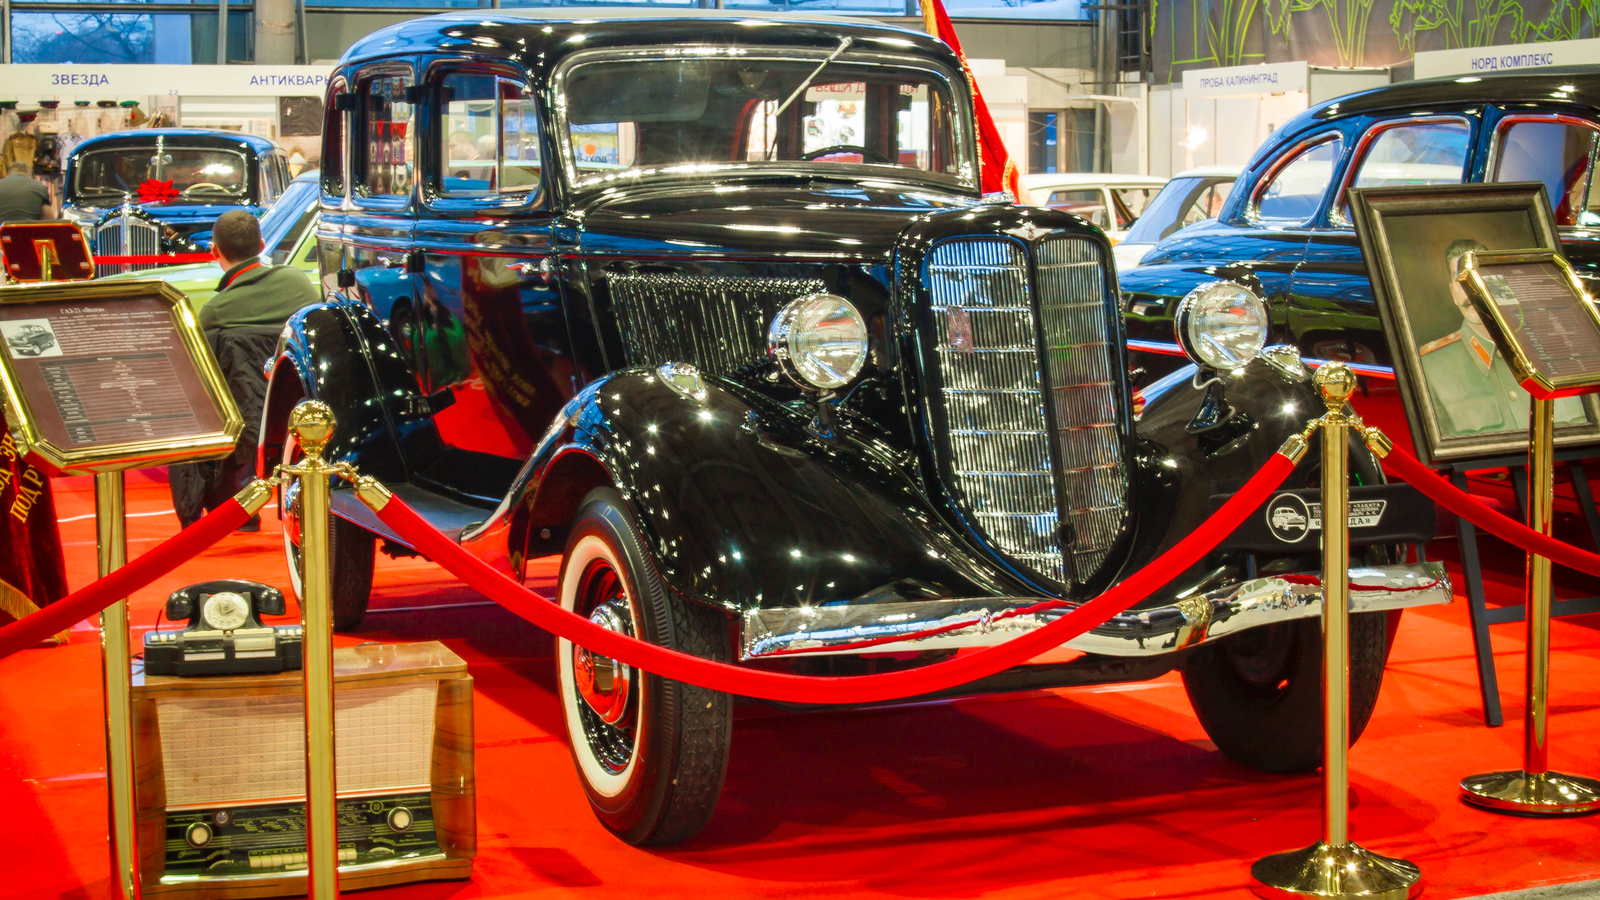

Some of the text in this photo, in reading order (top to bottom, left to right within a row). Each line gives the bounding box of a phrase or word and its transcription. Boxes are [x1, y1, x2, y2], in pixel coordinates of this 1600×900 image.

[1471, 53, 1553, 70] НОРД КОМПЛЕКС
[51, 74, 109, 86] ЗВЕЗДА
[1200, 73, 1278, 88] ПРОБА КАЛИНИНГРАД
[10, 485, 42, 523] ПОД
